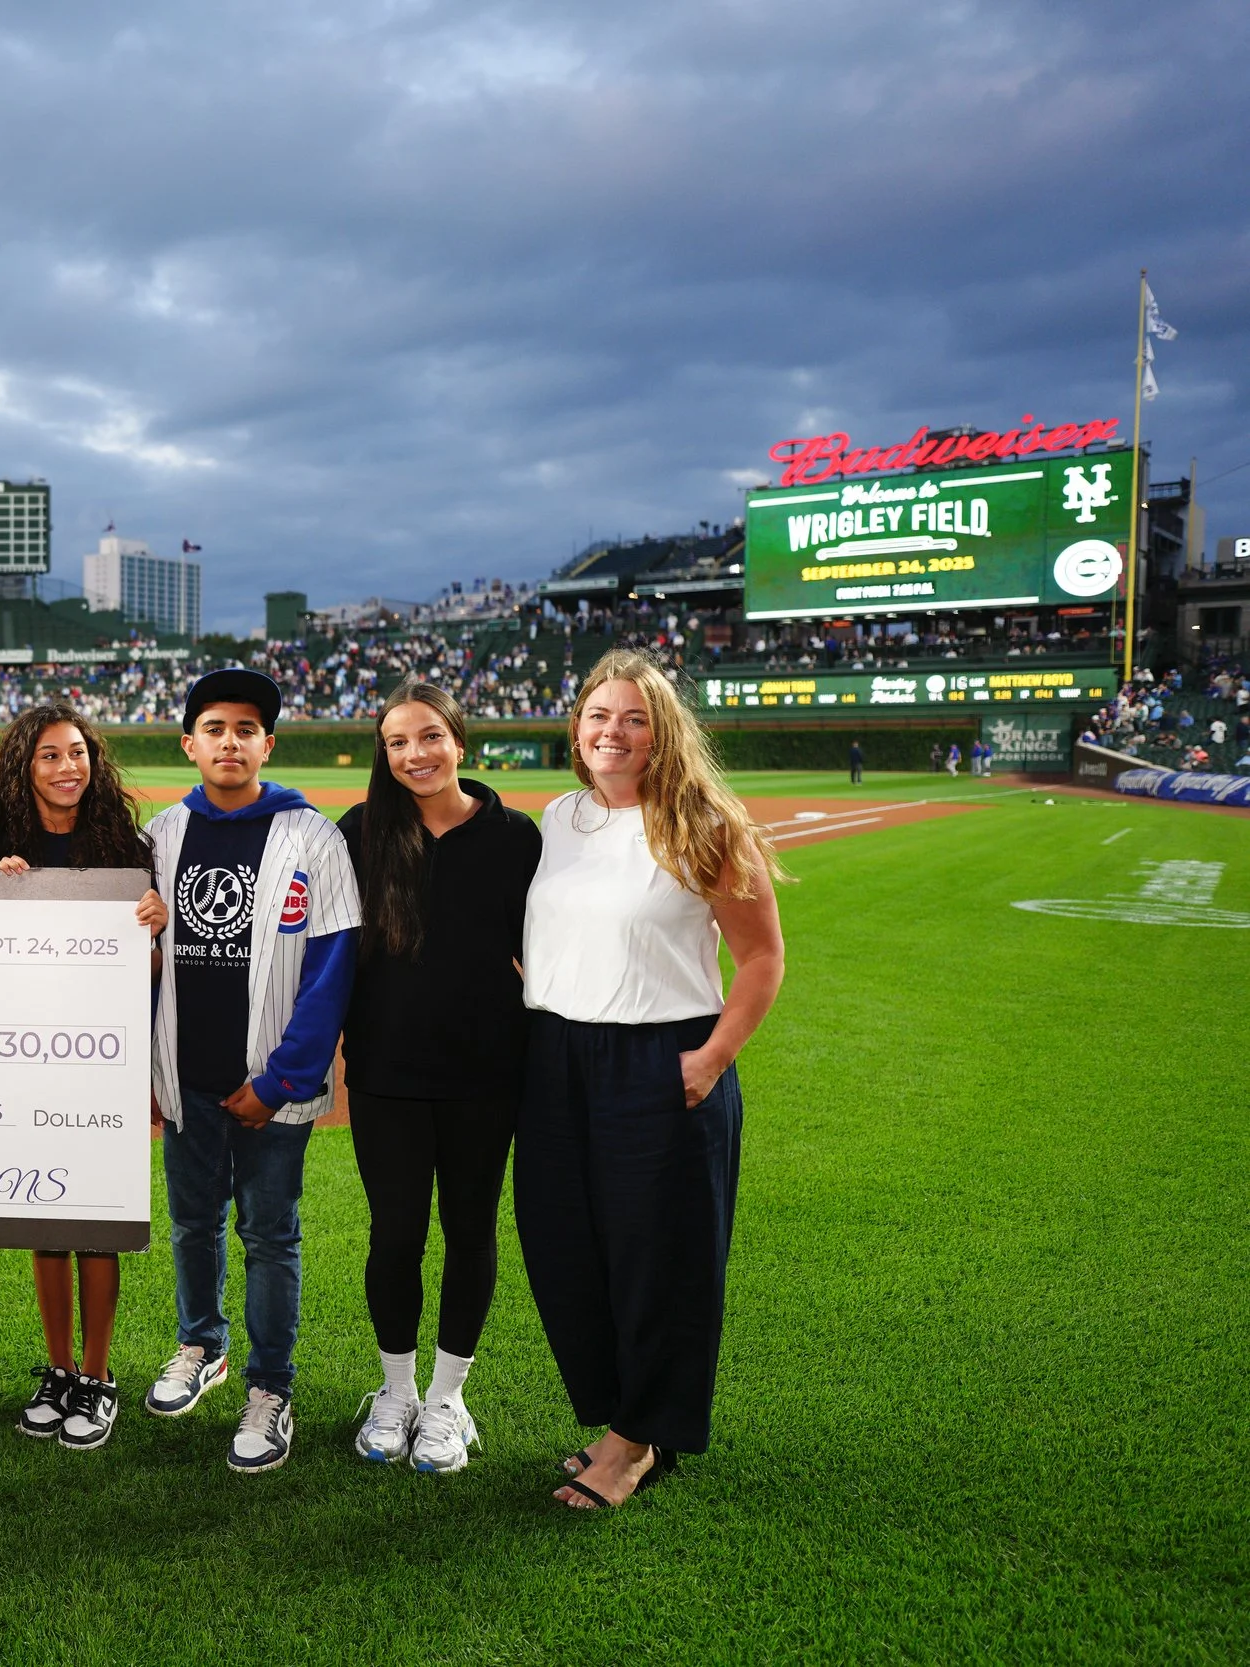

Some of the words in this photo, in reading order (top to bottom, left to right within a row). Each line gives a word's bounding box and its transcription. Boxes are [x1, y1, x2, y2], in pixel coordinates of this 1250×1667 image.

[769, 413, 1119, 486] Budweiser
[841, 481, 917, 506] Welcome
[918, 480, 940, 498] to
[788, 505, 903, 552] WRIGLEY
[911, 498, 989, 537] FIELD
[801, 561, 896, 581] SEPTEMBER
[927, 555, 975, 573] 2025
[47, 649, 117, 662] Budweiser
[144, 648, 190, 660] Advocate
[989, 674, 1042, 688] MATTHEW
[998, 729, 1061, 740] DRAFT
[1000, 740, 1058, 752] KINGS
[27, 938, 60, 958] 24,
[65, 938, 119, 956] 2025
[174, 944, 207, 957] RPOSE
[210, 943, 223, 958] &
[175, 959, 205, 967] WANSON
[34, 1109, 124, 1129] DOLLARS
